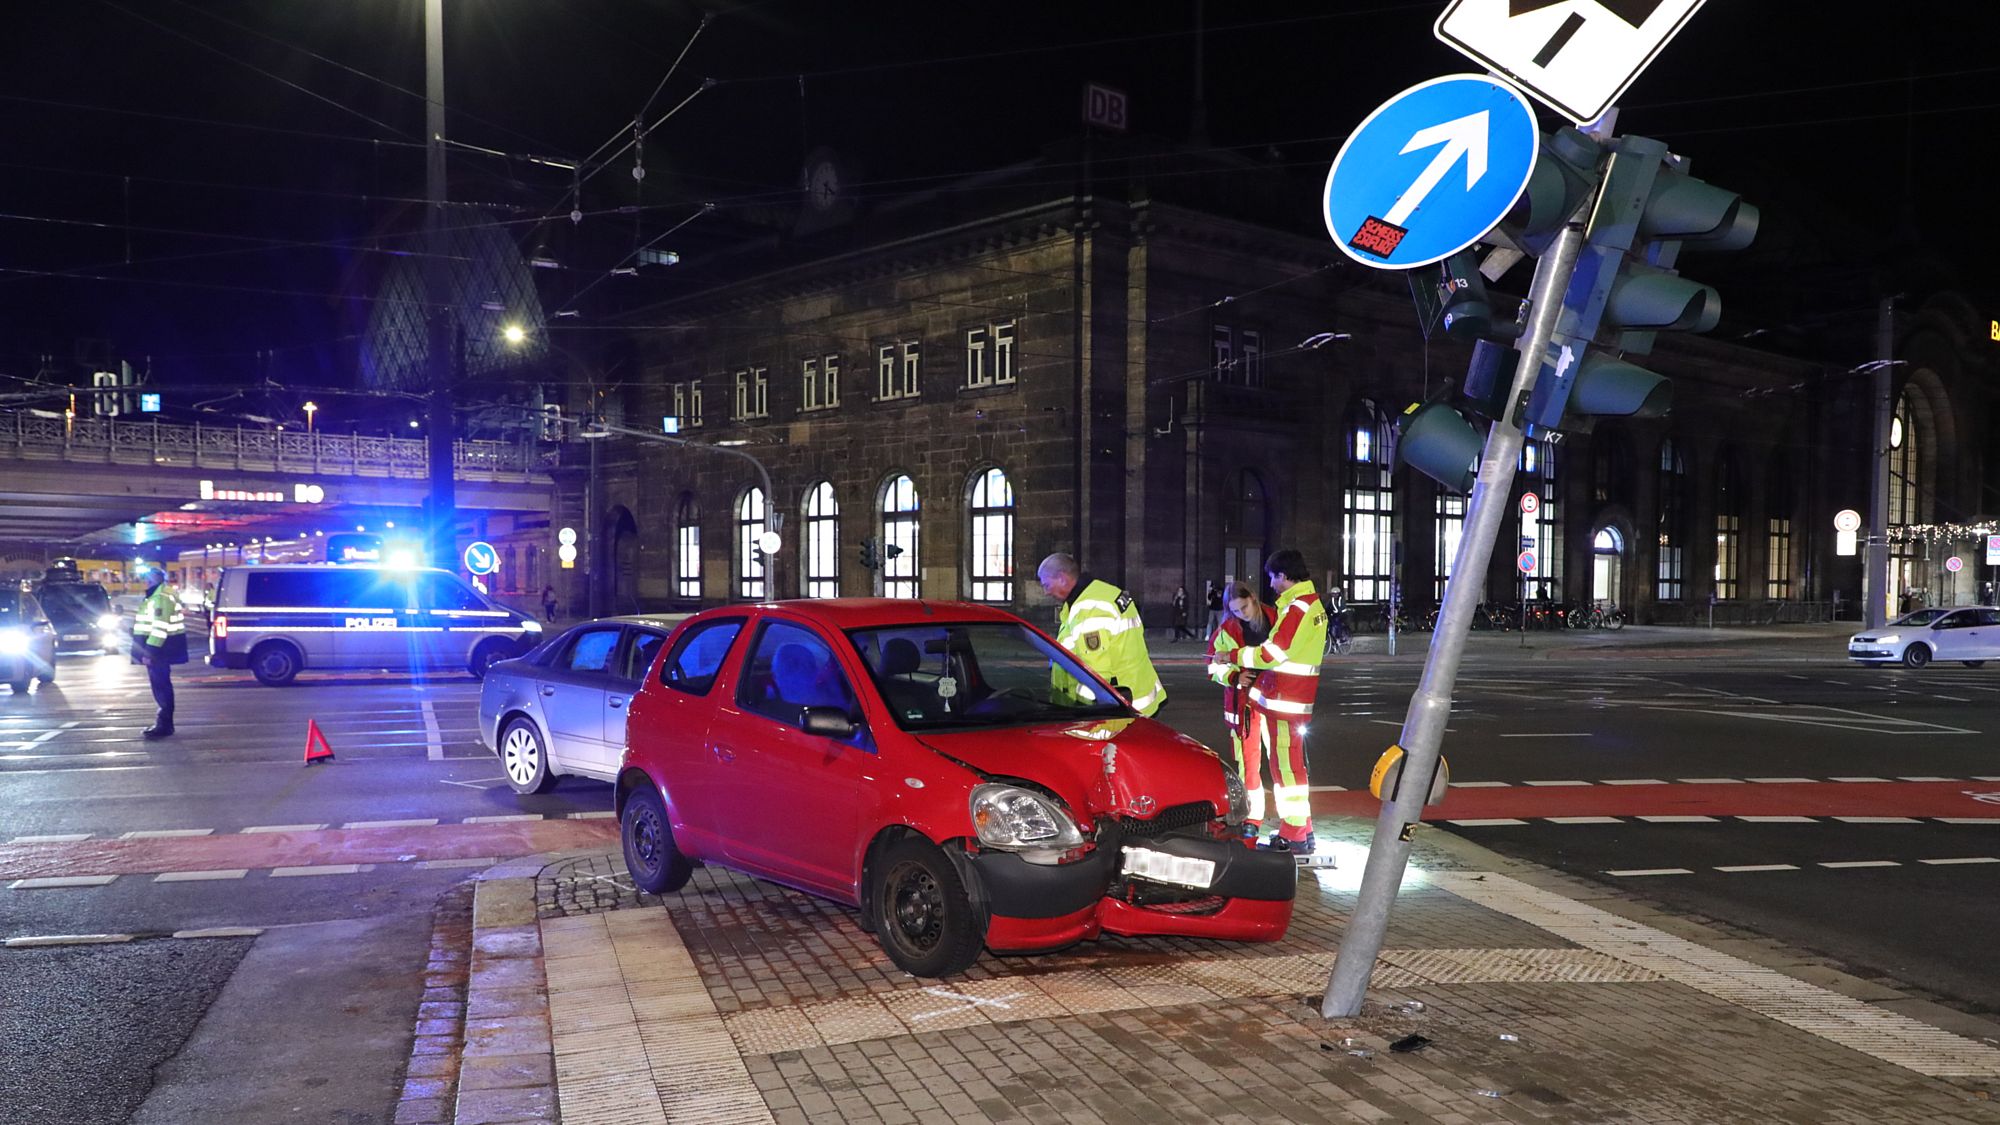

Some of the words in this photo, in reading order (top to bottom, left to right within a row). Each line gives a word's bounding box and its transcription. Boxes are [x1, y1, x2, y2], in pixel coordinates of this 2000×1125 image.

[1090, 89, 1124, 126] DB
[1361, 219, 1405, 243] SCHEISS
[1353, 230, 1399, 255] ERFURT
[1454, 278, 1468, 288] 13
[1544, 430, 1563, 444] K7
[345, 617, 398, 631] POLIZEI
